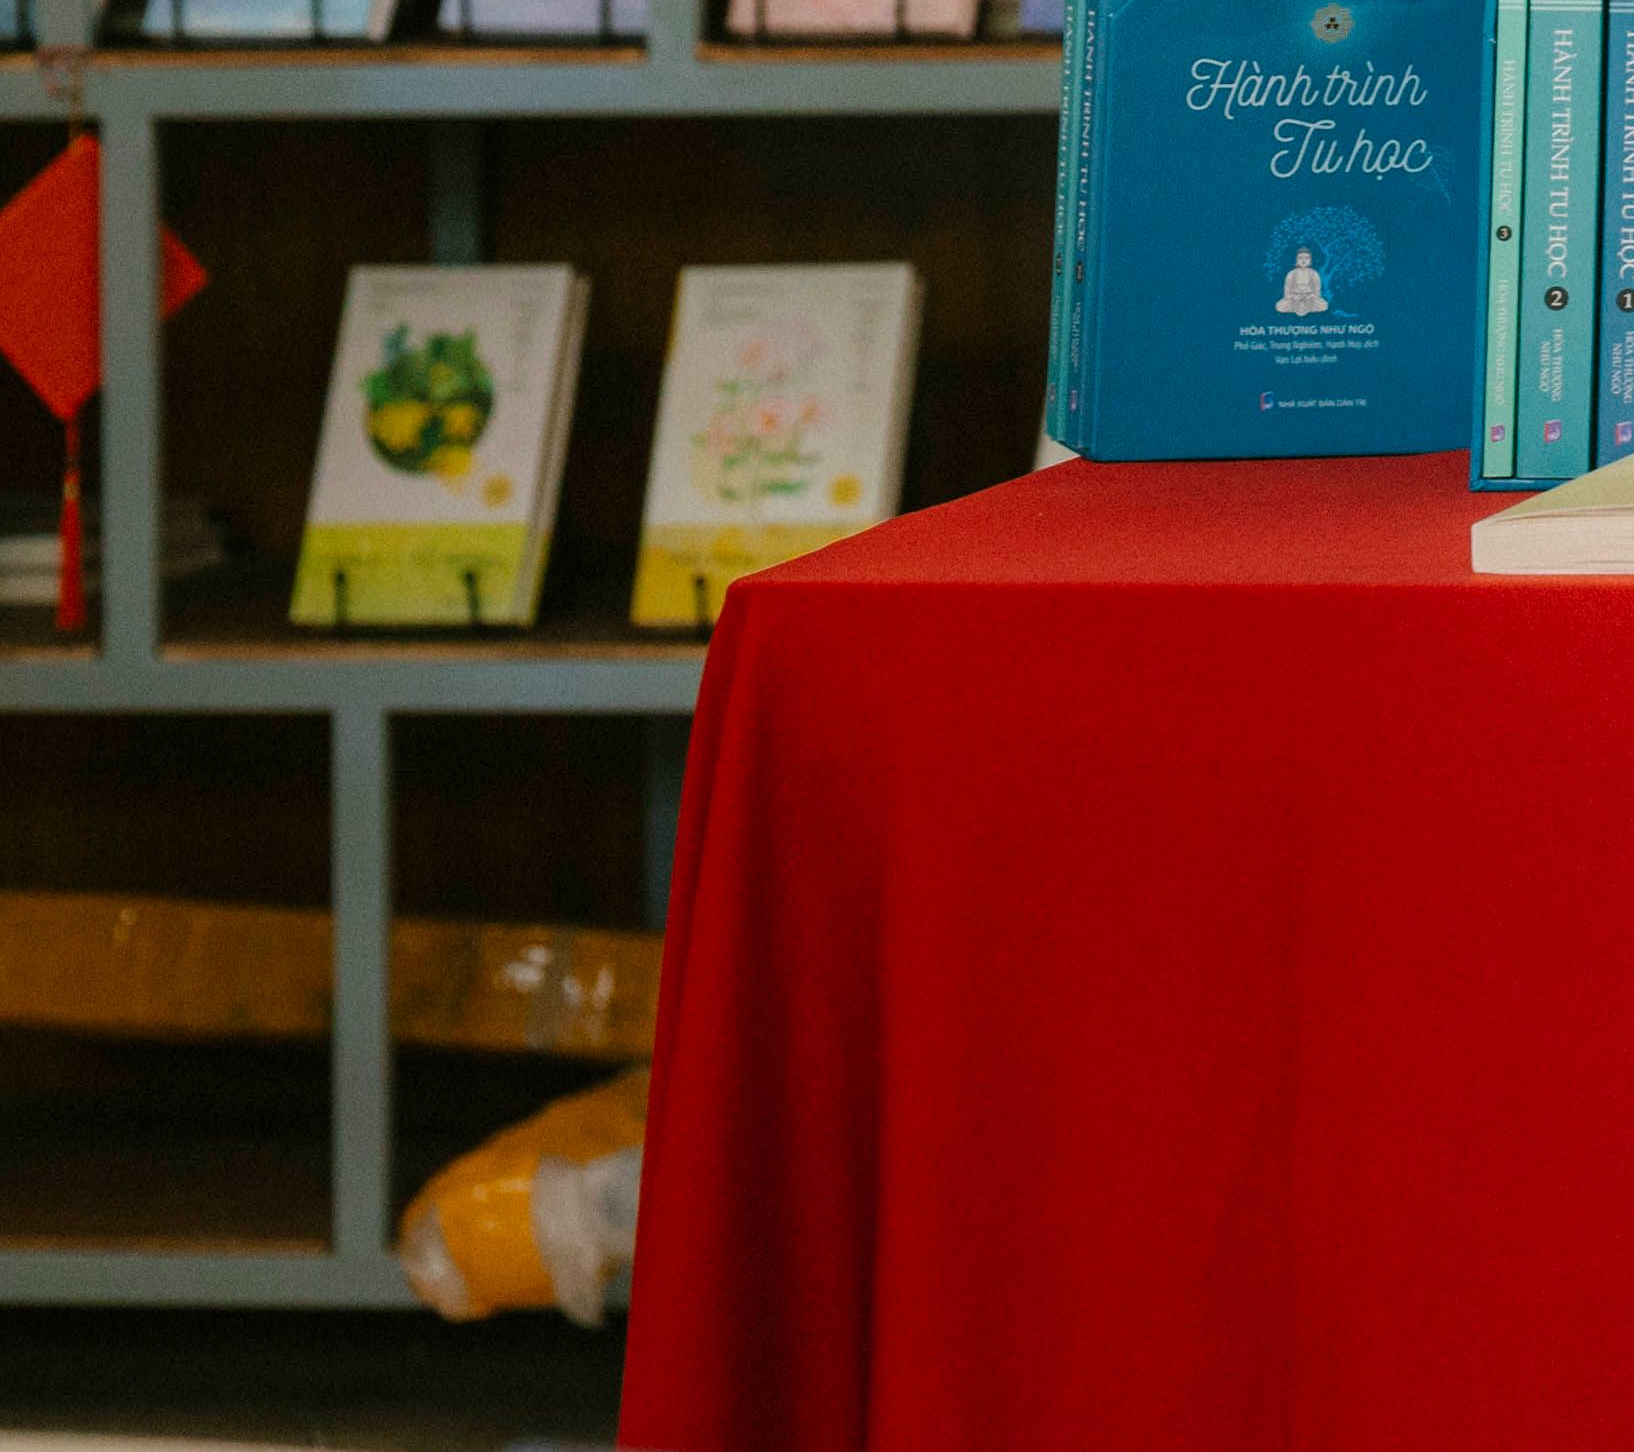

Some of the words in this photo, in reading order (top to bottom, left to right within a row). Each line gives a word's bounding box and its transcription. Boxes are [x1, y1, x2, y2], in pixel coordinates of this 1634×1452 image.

[1186, 58, 1319, 121] Hành
[1323, 60, 1428, 107] trình
[1551, 28, 1576, 102] HÀNH
[1270, 118, 1345, 180] Tu
[1345, 129, 1433, 181] học
[1549, 107, 1574, 181] TRÌNH
[1548, 186, 1568, 217] TU
[1544, 224, 1567, 278] HỌC
[1550, 290, 1563, 307] 2
[1623, 292, 1633, 309] 1
